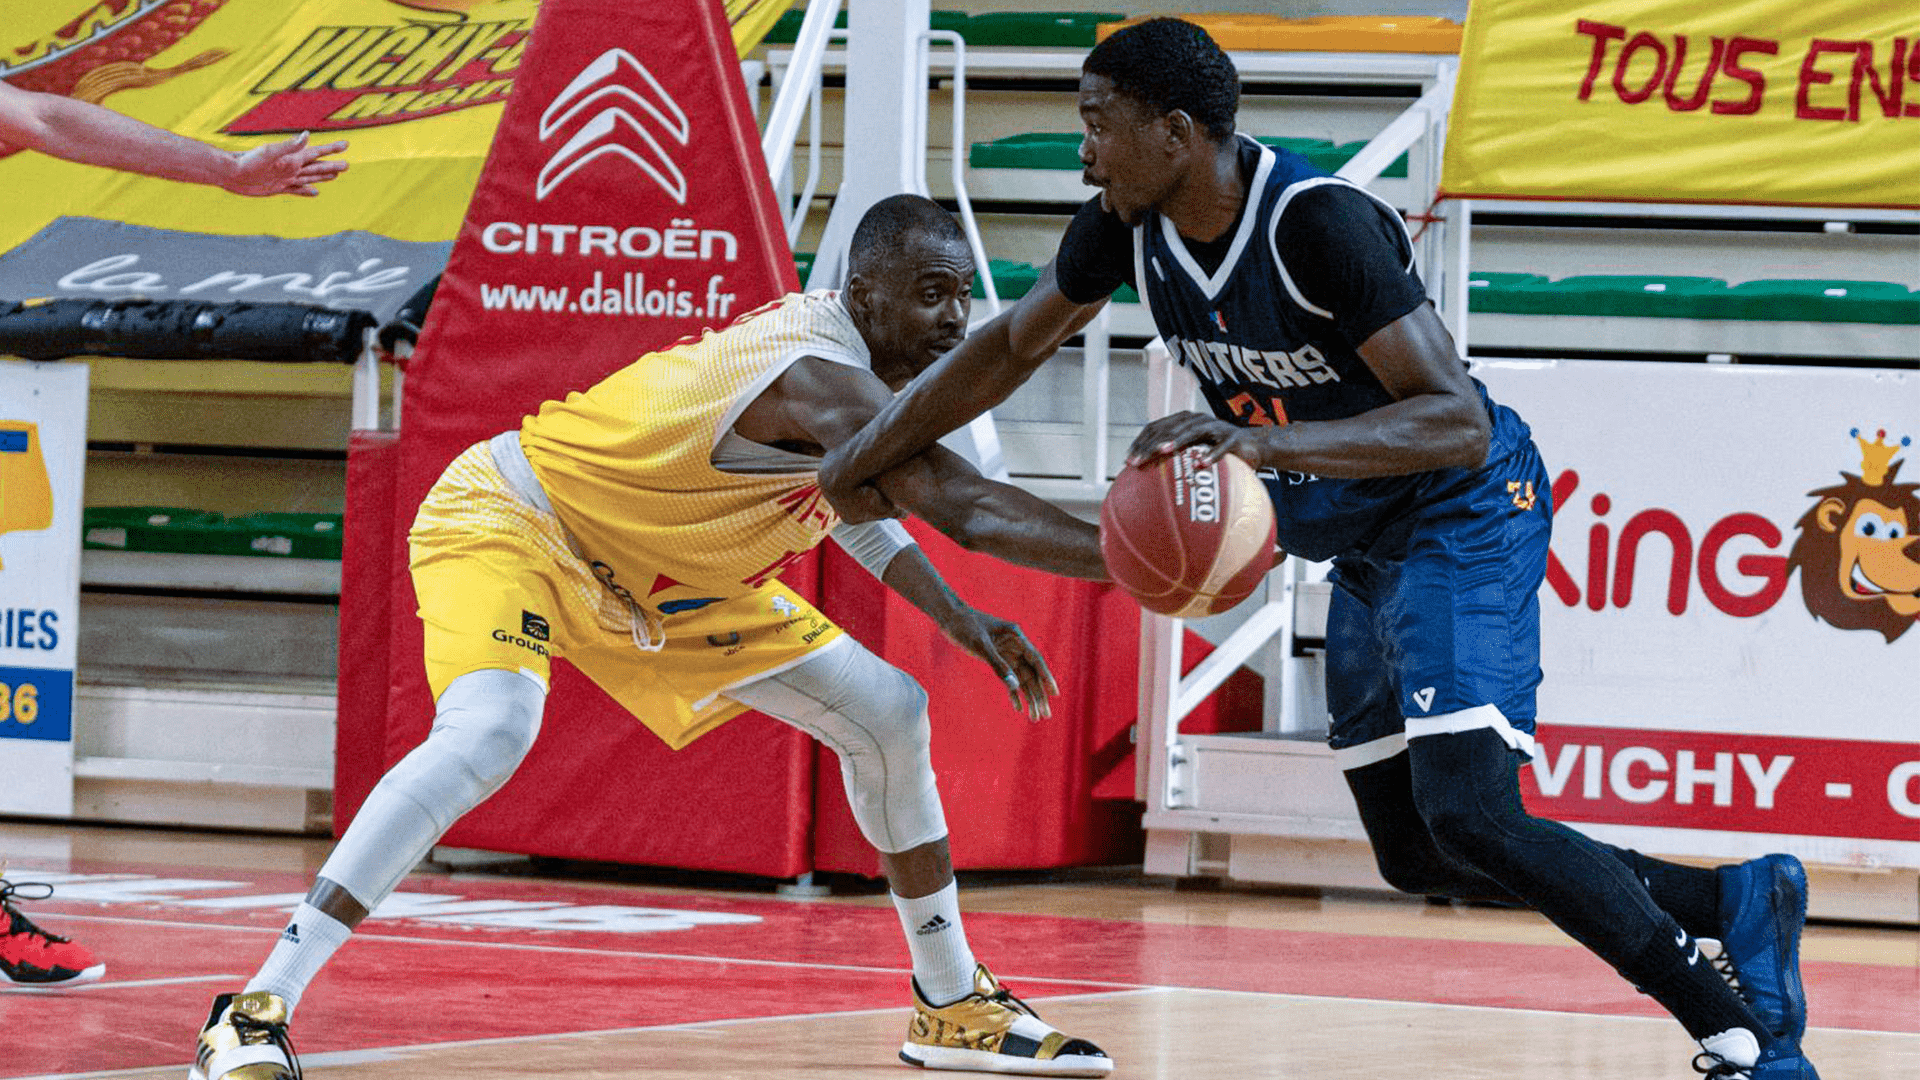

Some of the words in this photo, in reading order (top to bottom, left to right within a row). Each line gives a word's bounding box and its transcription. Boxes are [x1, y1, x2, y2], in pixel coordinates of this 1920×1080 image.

[1575, 19, 1780, 115] TOUS
[482, 218, 738, 262] CITROËN
[58, 254, 167, 290] la
[480, 271, 736, 318] www.dallois.fr
[0, 608, 59, 651] IES
[1532, 742, 1796, 810] VICHY
